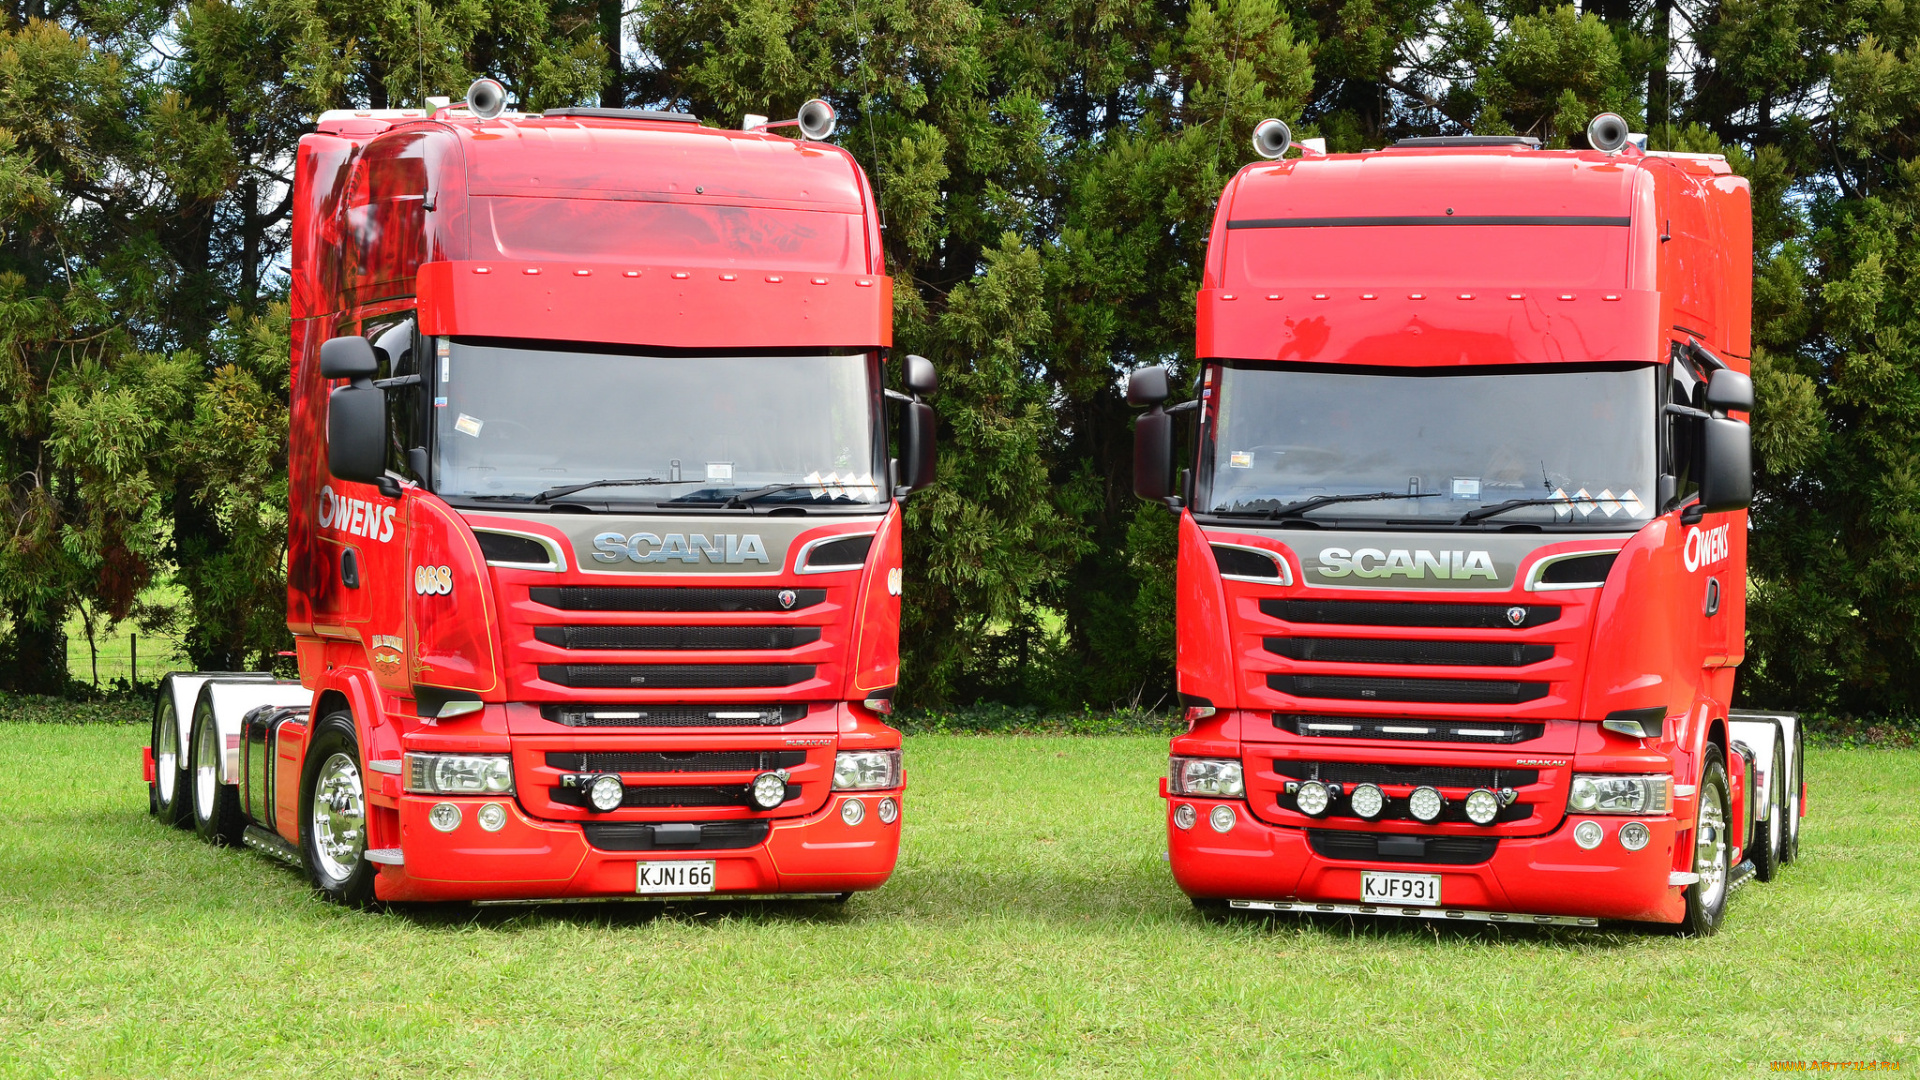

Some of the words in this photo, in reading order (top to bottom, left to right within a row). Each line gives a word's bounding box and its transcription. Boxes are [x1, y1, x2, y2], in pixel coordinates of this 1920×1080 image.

[318, 485, 397, 543] OWENS
[592, 532, 769, 564] SCANIA
[1317, 547, 1499, 580] SCANIA
[1683, 522, 1729, 573] OWENS
[414, 565, 452, 595] 668
[640, 867, 711, 886] KJN166
[1365, 877, 1434, 899] KJF931
